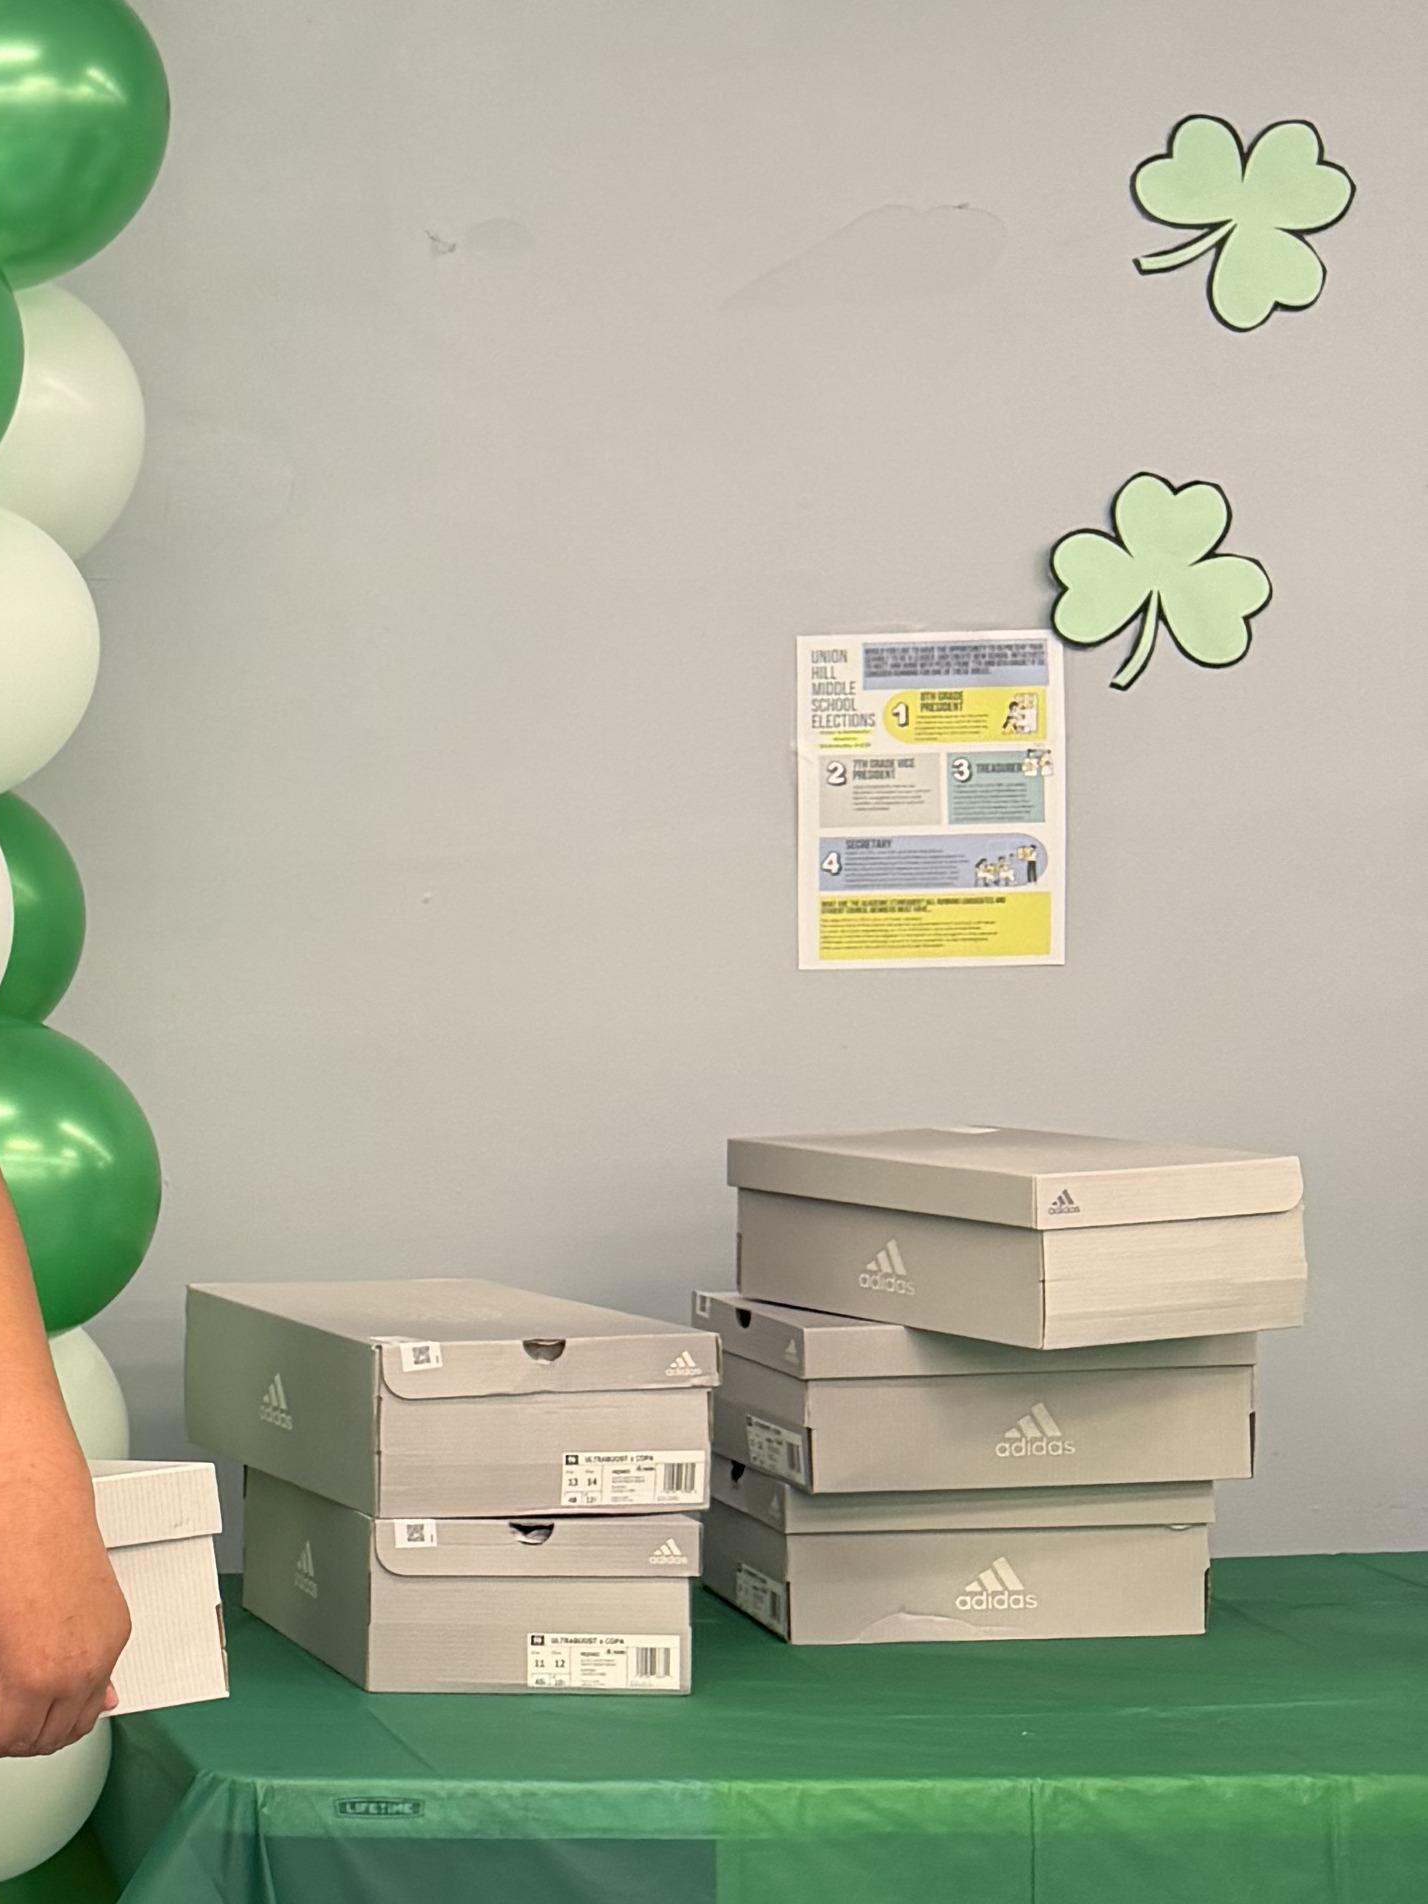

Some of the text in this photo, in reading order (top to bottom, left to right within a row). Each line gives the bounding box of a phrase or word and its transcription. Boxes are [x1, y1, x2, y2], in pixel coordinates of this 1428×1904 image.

[810, 649, 848, 664] UNION
[810, 665, 837, 680] HILL
[810, 681, 857, 696] MIDDLE
[810, 697, 857, 712] SCHOOL
[891, 701, 909, 727] 1
[810, 713, 876, 729] ELECTIONS
[826, 760, 847, 786] 2
[952, 757, 973, 783] 3
[820, 850, 842, 876] 4
[858, 1272, 916, 1296] adidas
[995, 1437, 1076, 1457] adidas
[955, 1590, 1038, 1610] adidas
[345, 1801, 414, 1815] LIFETIME
